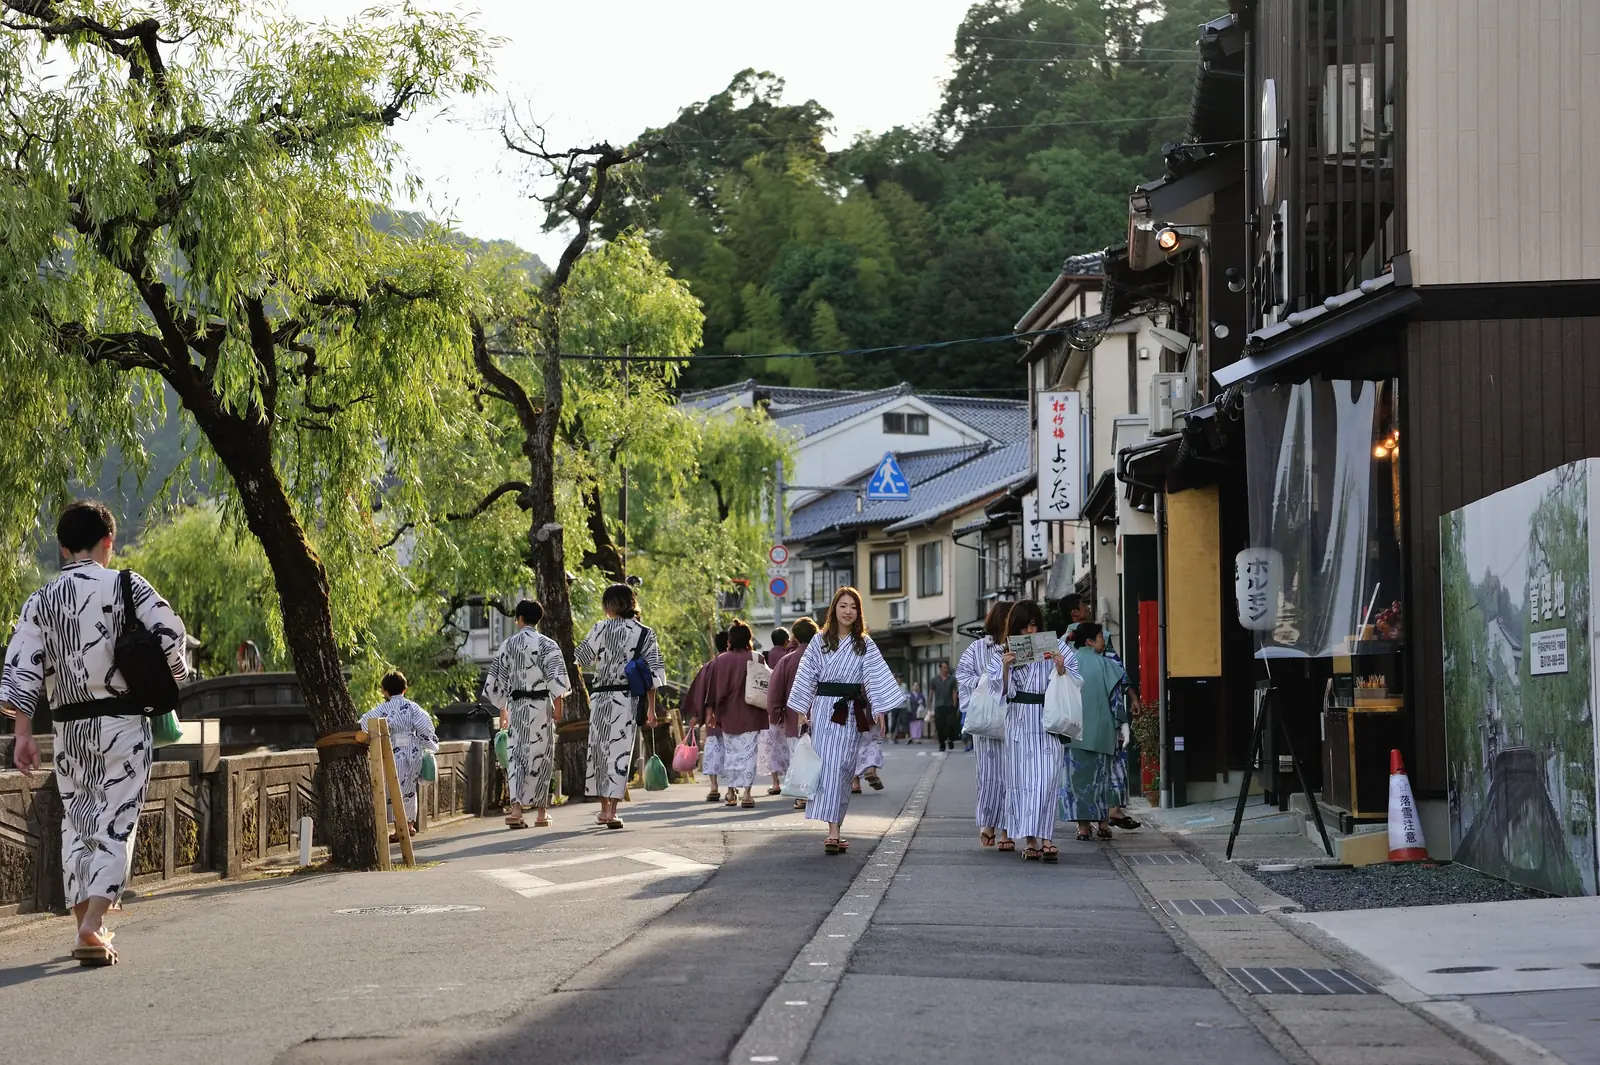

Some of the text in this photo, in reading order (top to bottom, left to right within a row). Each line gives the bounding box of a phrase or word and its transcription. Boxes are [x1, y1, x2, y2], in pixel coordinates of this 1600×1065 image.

[1052, 400, 1066, 439] 松竹梅
[1247, 556, 1269, 622] ホルモン
[1529, 569, 1566, 623] 管理地
[1400, 794, 1417, 843] 落雪注意
